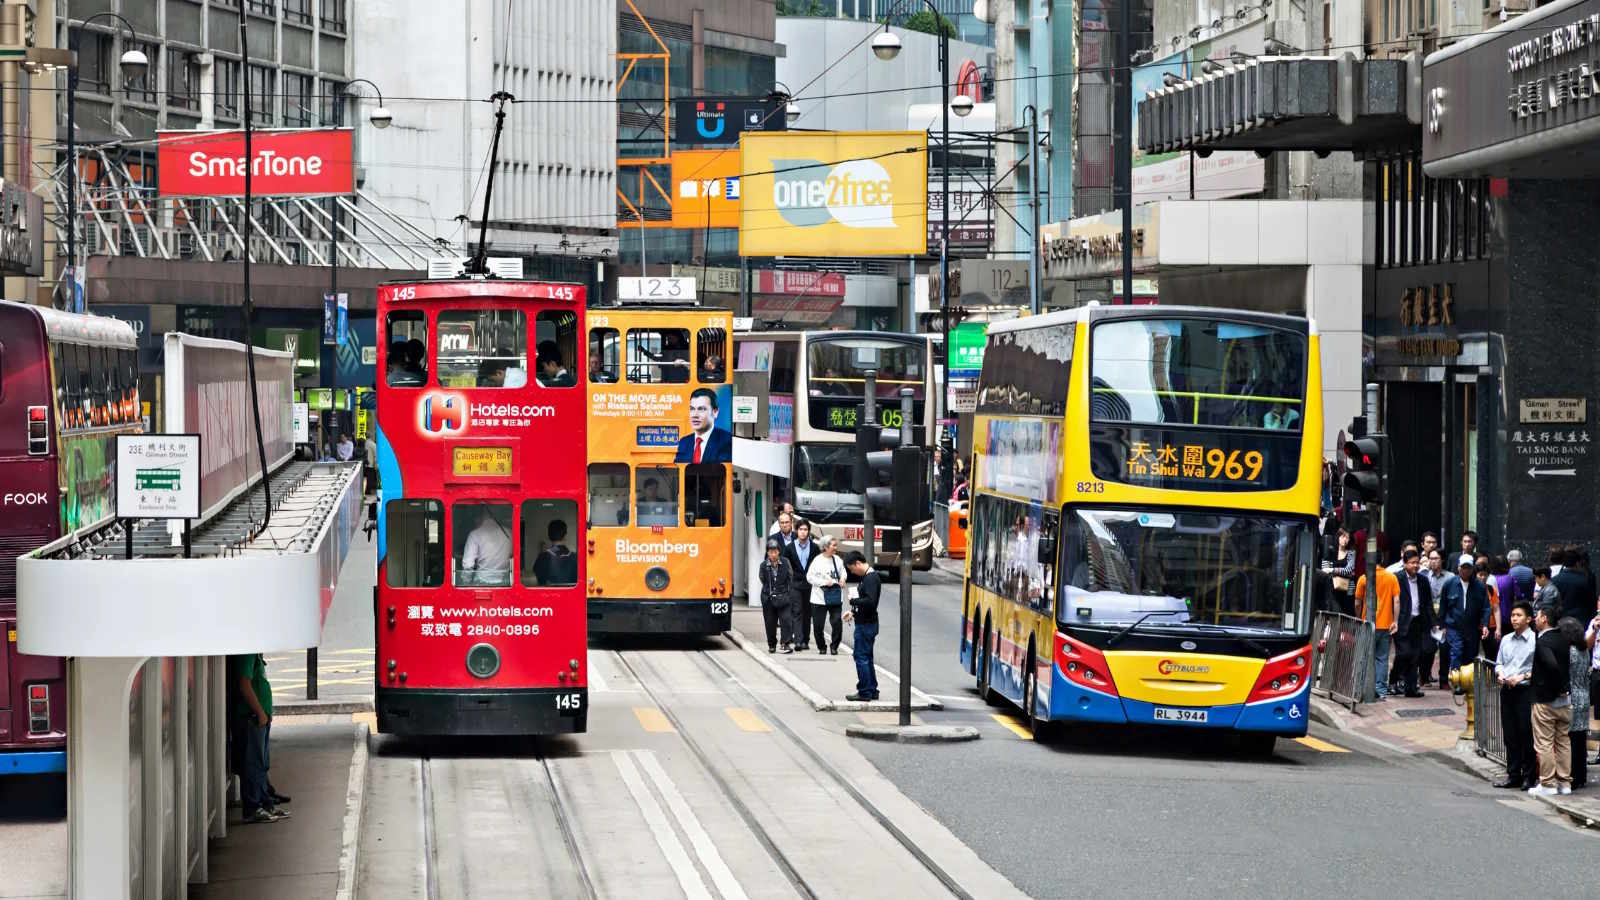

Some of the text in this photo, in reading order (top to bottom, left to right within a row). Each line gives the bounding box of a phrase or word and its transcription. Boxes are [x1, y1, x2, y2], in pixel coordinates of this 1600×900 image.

[189, 150, 322, 177] SmarTone
[774, 172, 893, 207] one2free
[392, 287, 416, 301] 145
[548, 287, 574, 300] 145
[637, 279, 682, 296] 123
[590, 316, 609, 327] 123
[707, 317, 726, 328] 123
[592, 393, 683, 404] ON THE MOVE ASIA
[1526, 400, 1580, 408] Gilman Street
[470, 402, 555, 417] Hotels.com
[455, 450, 511, 462] Causeway Bay
[1516, 446, 1587, 454] TAI SANG BANK
[1130, 440, 1264, 481] 天水圍 969
[1529, 457, 1574, 465] BUILDING
[1127, 461, 1206, 479] Tin Shui Wai
[1076, 482, 1105, 494] 8213
[4, 492, 48, 505] FOOK
[615, 539, 699, 558] Bloomberg
[615, 554, 668, 563] TELEVISION
[439, 605, 553, 618] www.hotels.com
[711, 602, 729, 614] 123
[466, 624, 540, 637] 2840-0896
[555, 694, 581, 709] 145
[1156, 709, 1206, 721] RL 3944
